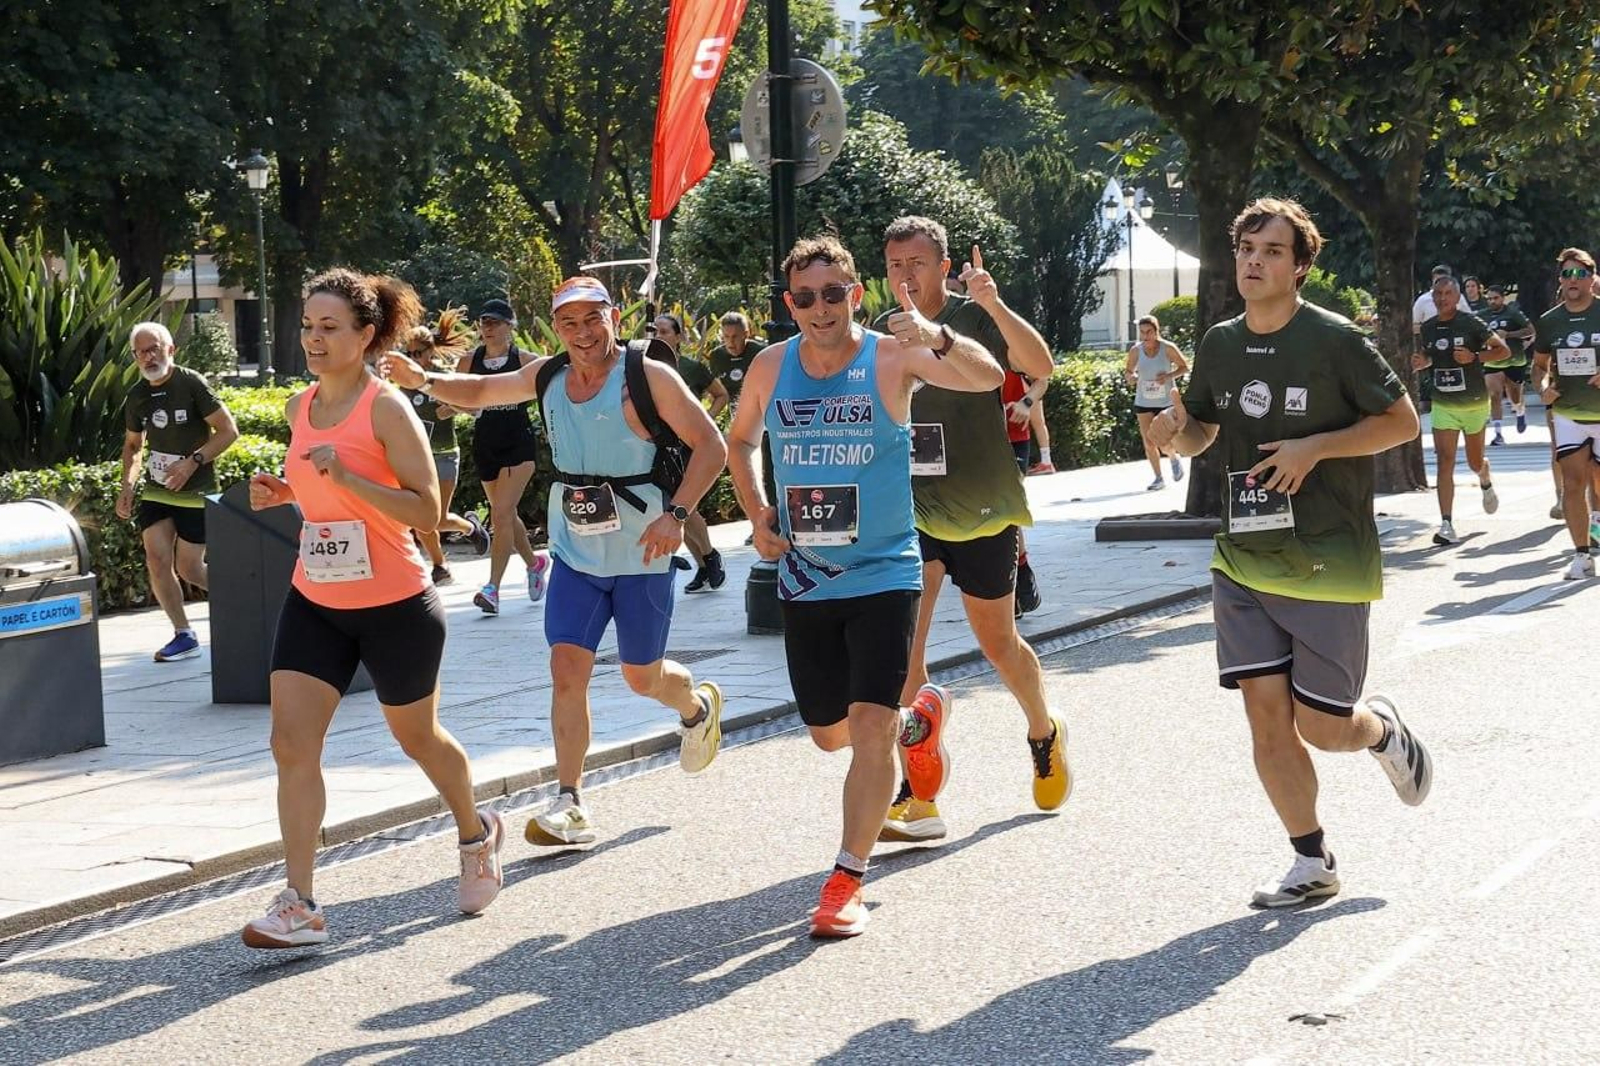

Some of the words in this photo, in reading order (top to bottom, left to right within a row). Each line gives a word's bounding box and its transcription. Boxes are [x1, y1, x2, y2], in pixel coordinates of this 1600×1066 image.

[692, 36, 726, 79] 5
[847, 368, 866, 380] HH
[824, 394, 873, 406] COMERCIAL
[823, 405, 874, 424] ULSA
[822, 428, 873, 437] INDUSTRIALES
[782, 443, 875, 465] ATLETISMO
[1239, 489, 1268, 504] 445
[569, 502, 597, 514] 220
[801, 504, 836, 519] 167
[309, 540, 350, 556] 1487
[1, 612, 31, 626] PAPEL
[32, 611, 38, 621] E
[40, 604, 76, 620] CARTÓN
